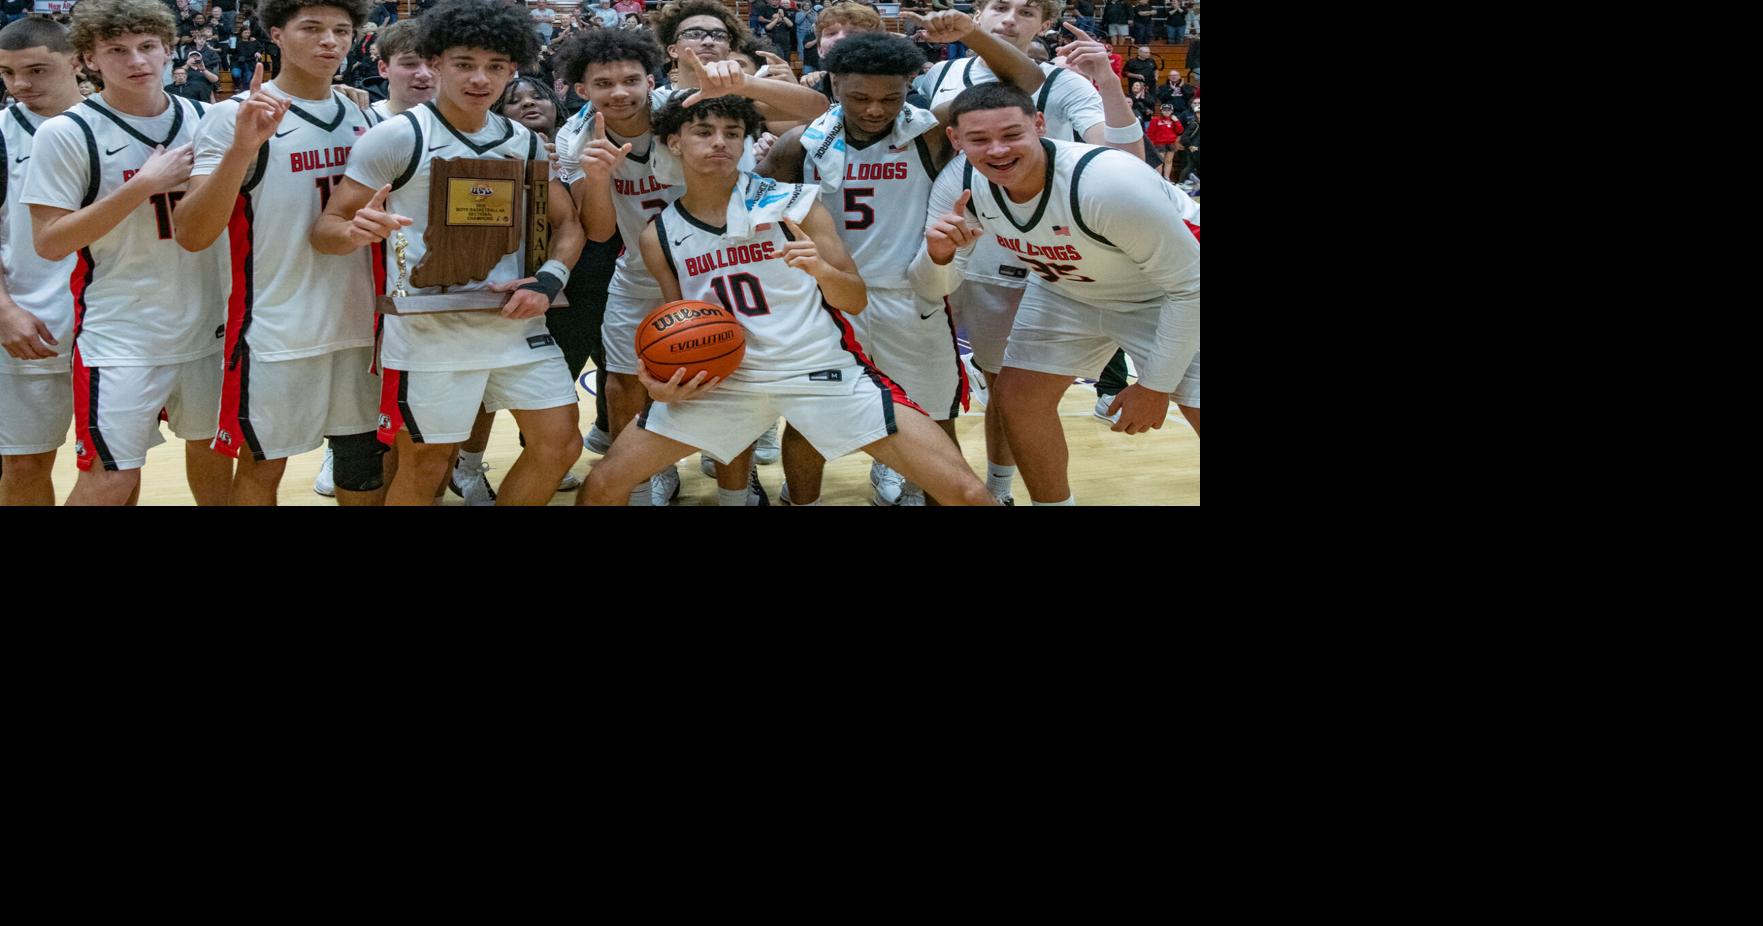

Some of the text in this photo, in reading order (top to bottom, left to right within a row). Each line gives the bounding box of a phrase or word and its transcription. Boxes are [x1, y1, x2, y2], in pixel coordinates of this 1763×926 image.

[290, 146, 352, 173] BULLD
[843, 187, 875, 230] 5
[685, 241, 775, 277] BULLDOGS
[710, 272, 771, 318] 10
[651, 307, 724, 332] Wilson
[670, 329, 735, 353] EVOLUTION
